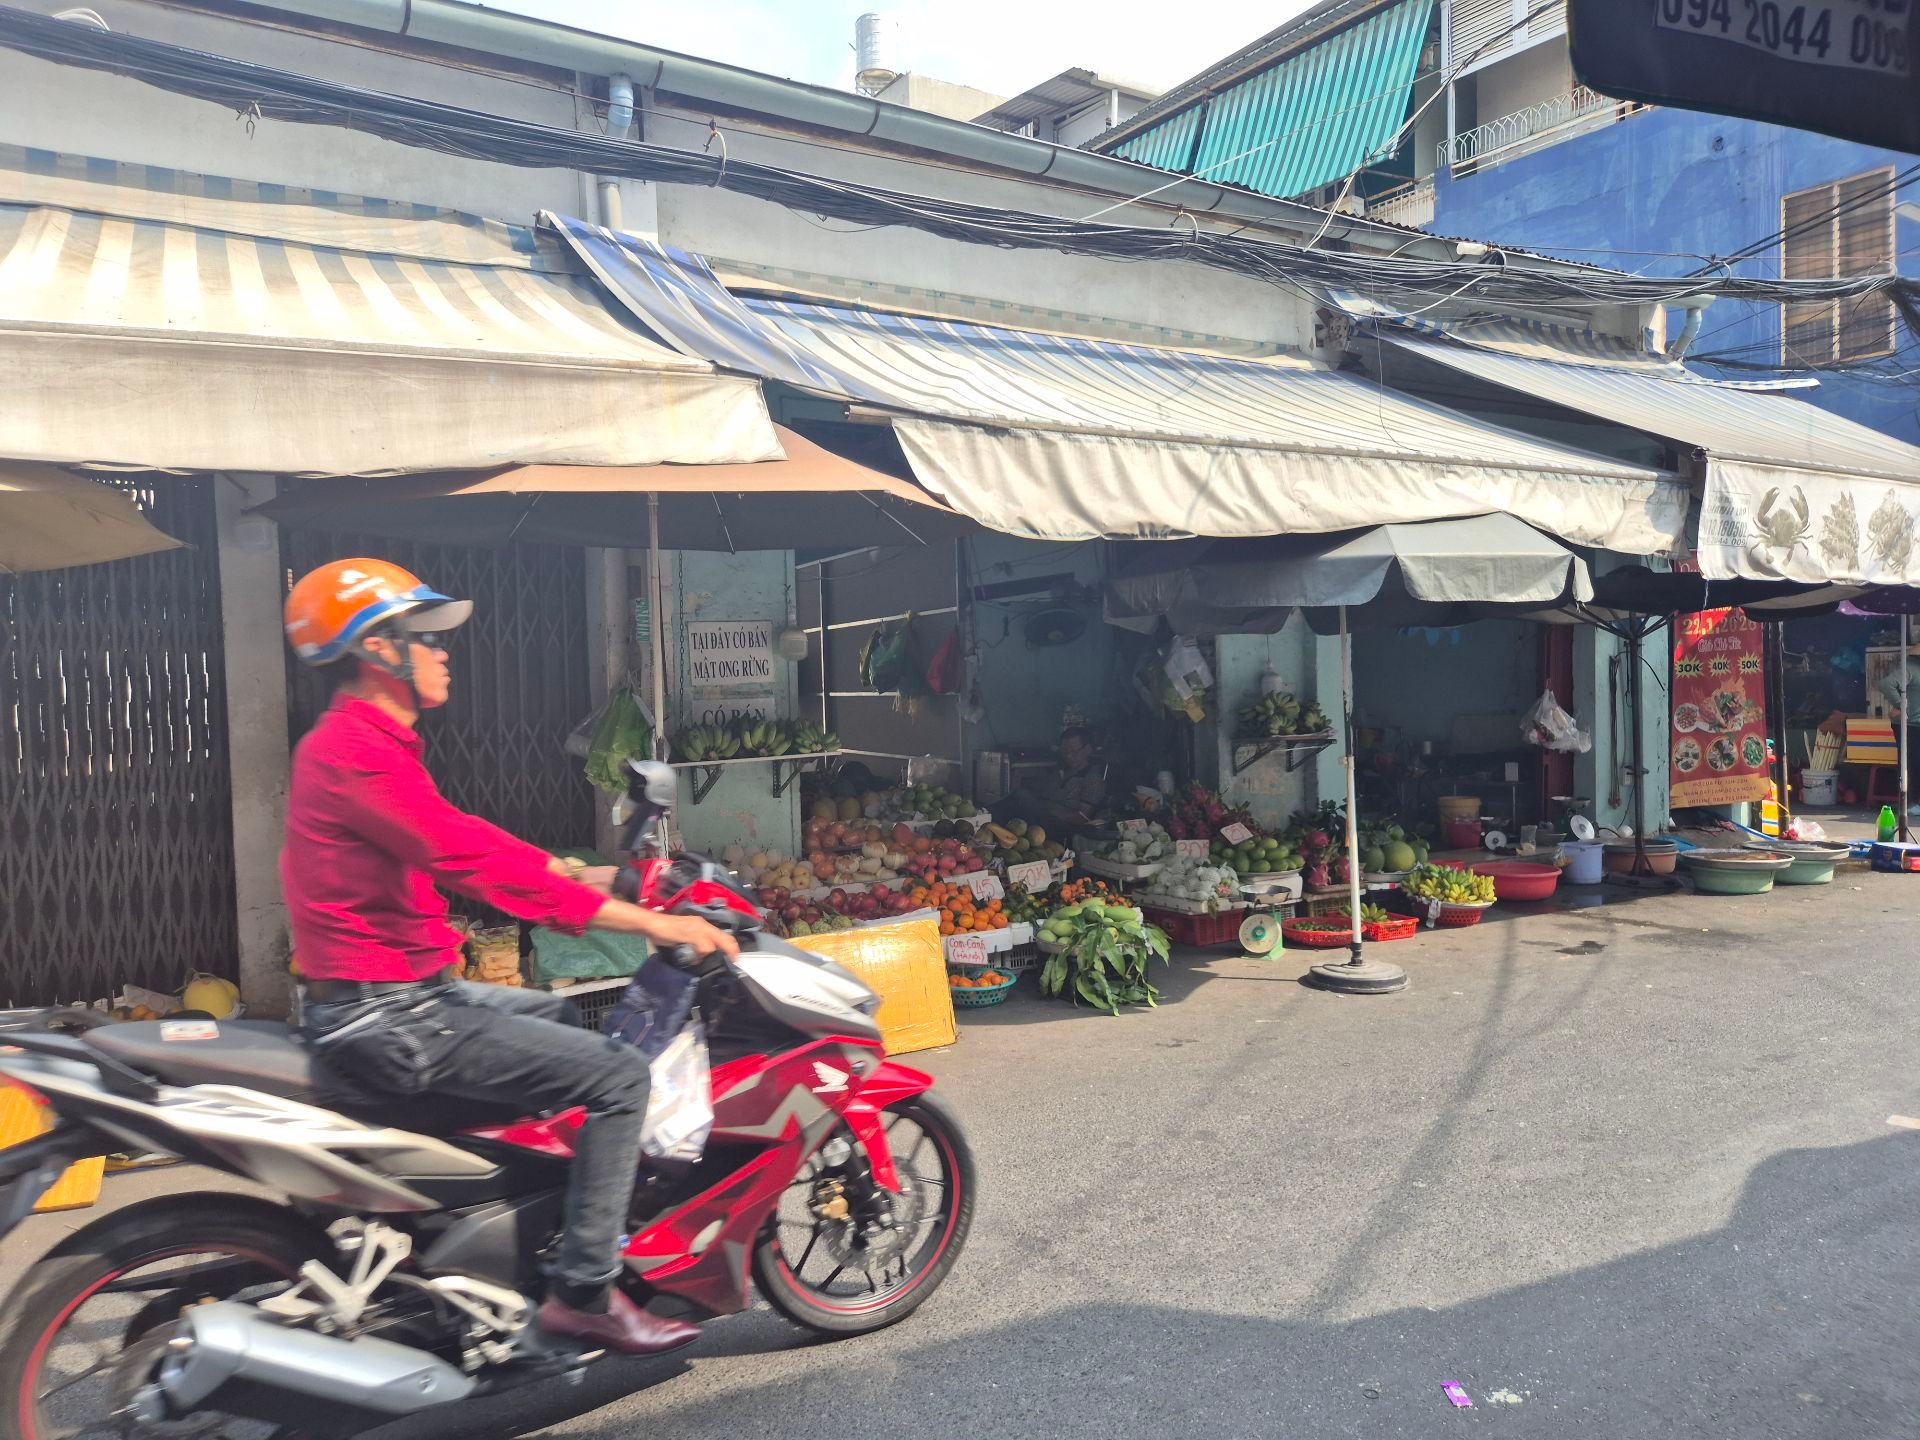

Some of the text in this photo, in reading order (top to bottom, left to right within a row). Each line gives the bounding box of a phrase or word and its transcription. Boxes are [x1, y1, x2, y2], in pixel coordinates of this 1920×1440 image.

[1663, 0, 1731, 32] 094
[1745, 0, 1832, 58] 2044
[691, 625, 768, 653] TẠI ĐÂY CÓ BÁN
[694, 655, 769, 682] MẬT ONG RỪNG
[1678, 659, 1758, 674] 30K 40K 50K
[975, 879, 995, 899] 45
